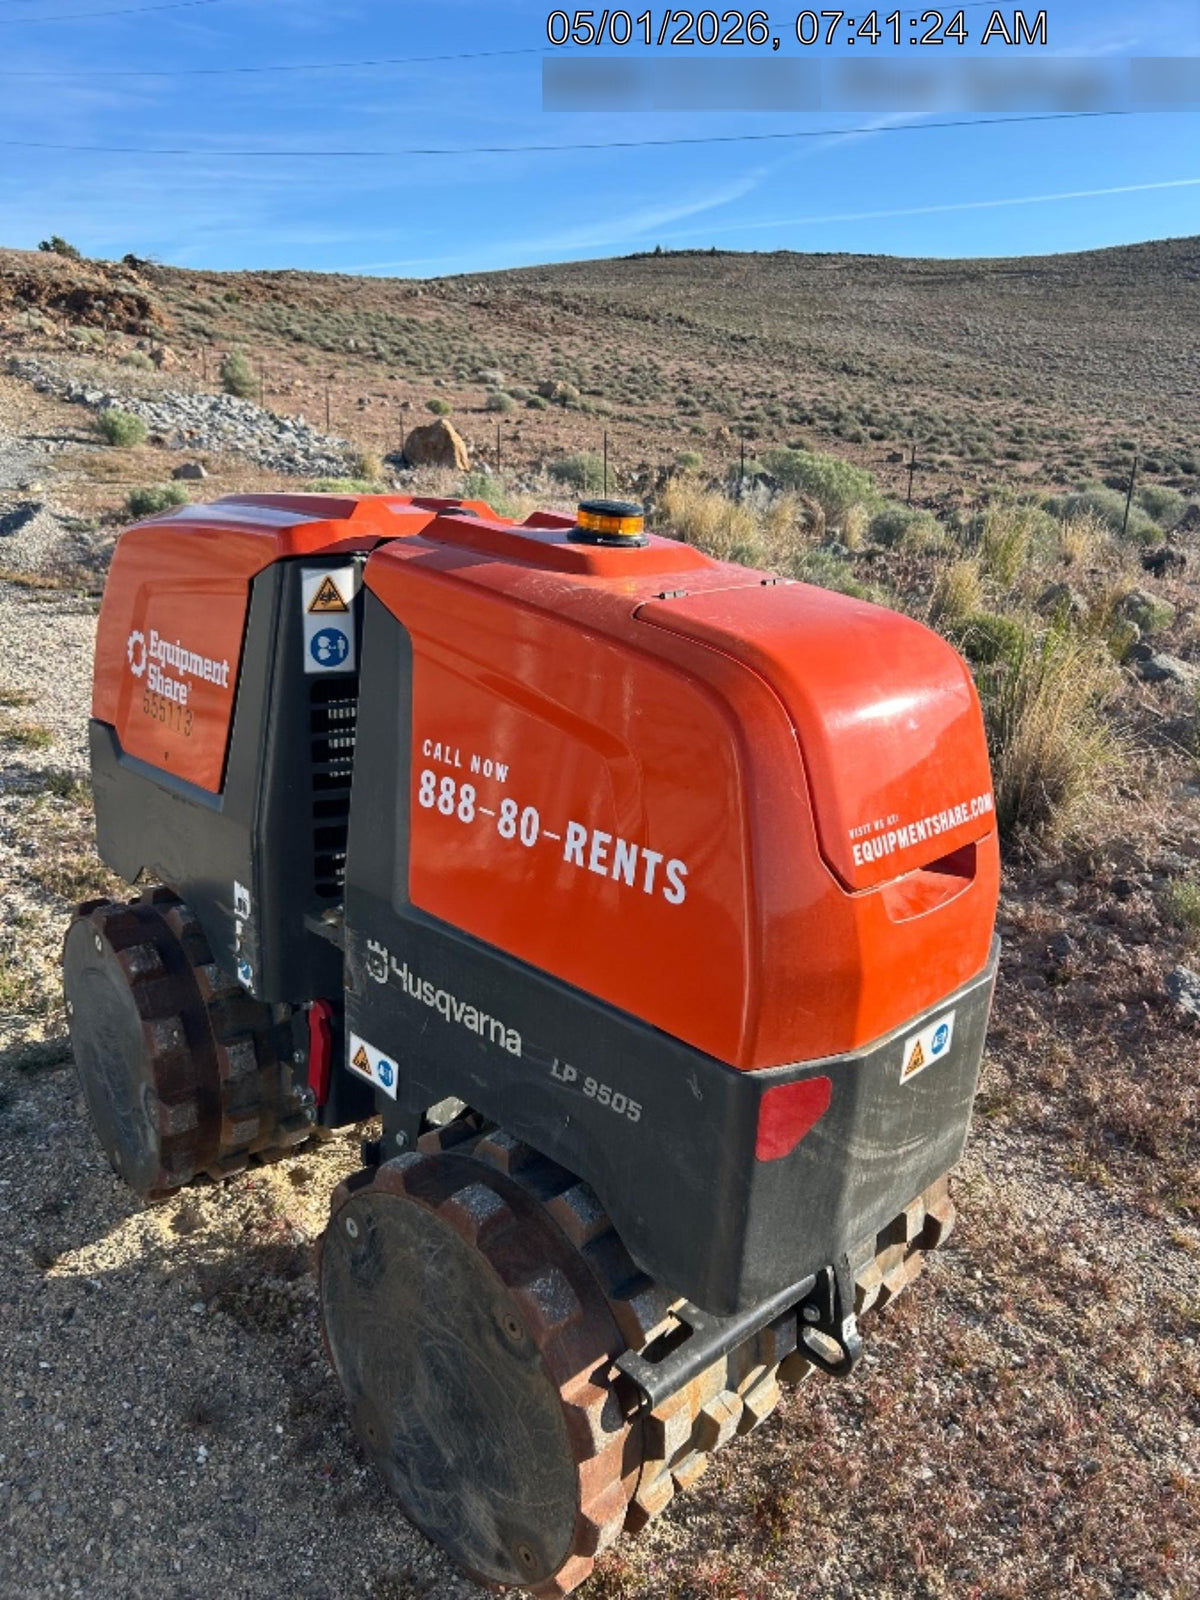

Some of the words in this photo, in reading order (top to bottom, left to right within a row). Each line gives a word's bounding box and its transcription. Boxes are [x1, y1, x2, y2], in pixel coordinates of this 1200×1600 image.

[147, 664, 188, 704] Share
[150, 630, 229, 688] Equipment
[423, 739, 461, 767] CALL
[470, 754, 509, 782] NOW
[419, 769, 688, 904] 888-80-RENTS
[852, 792, 994, 866] EQUIPMENTSHARE.COM
[391, 956, 522, 1057] Husqvarna
[551, 1058, 577, 1082] LP
[582, 1076, 643, 1122] 9505
